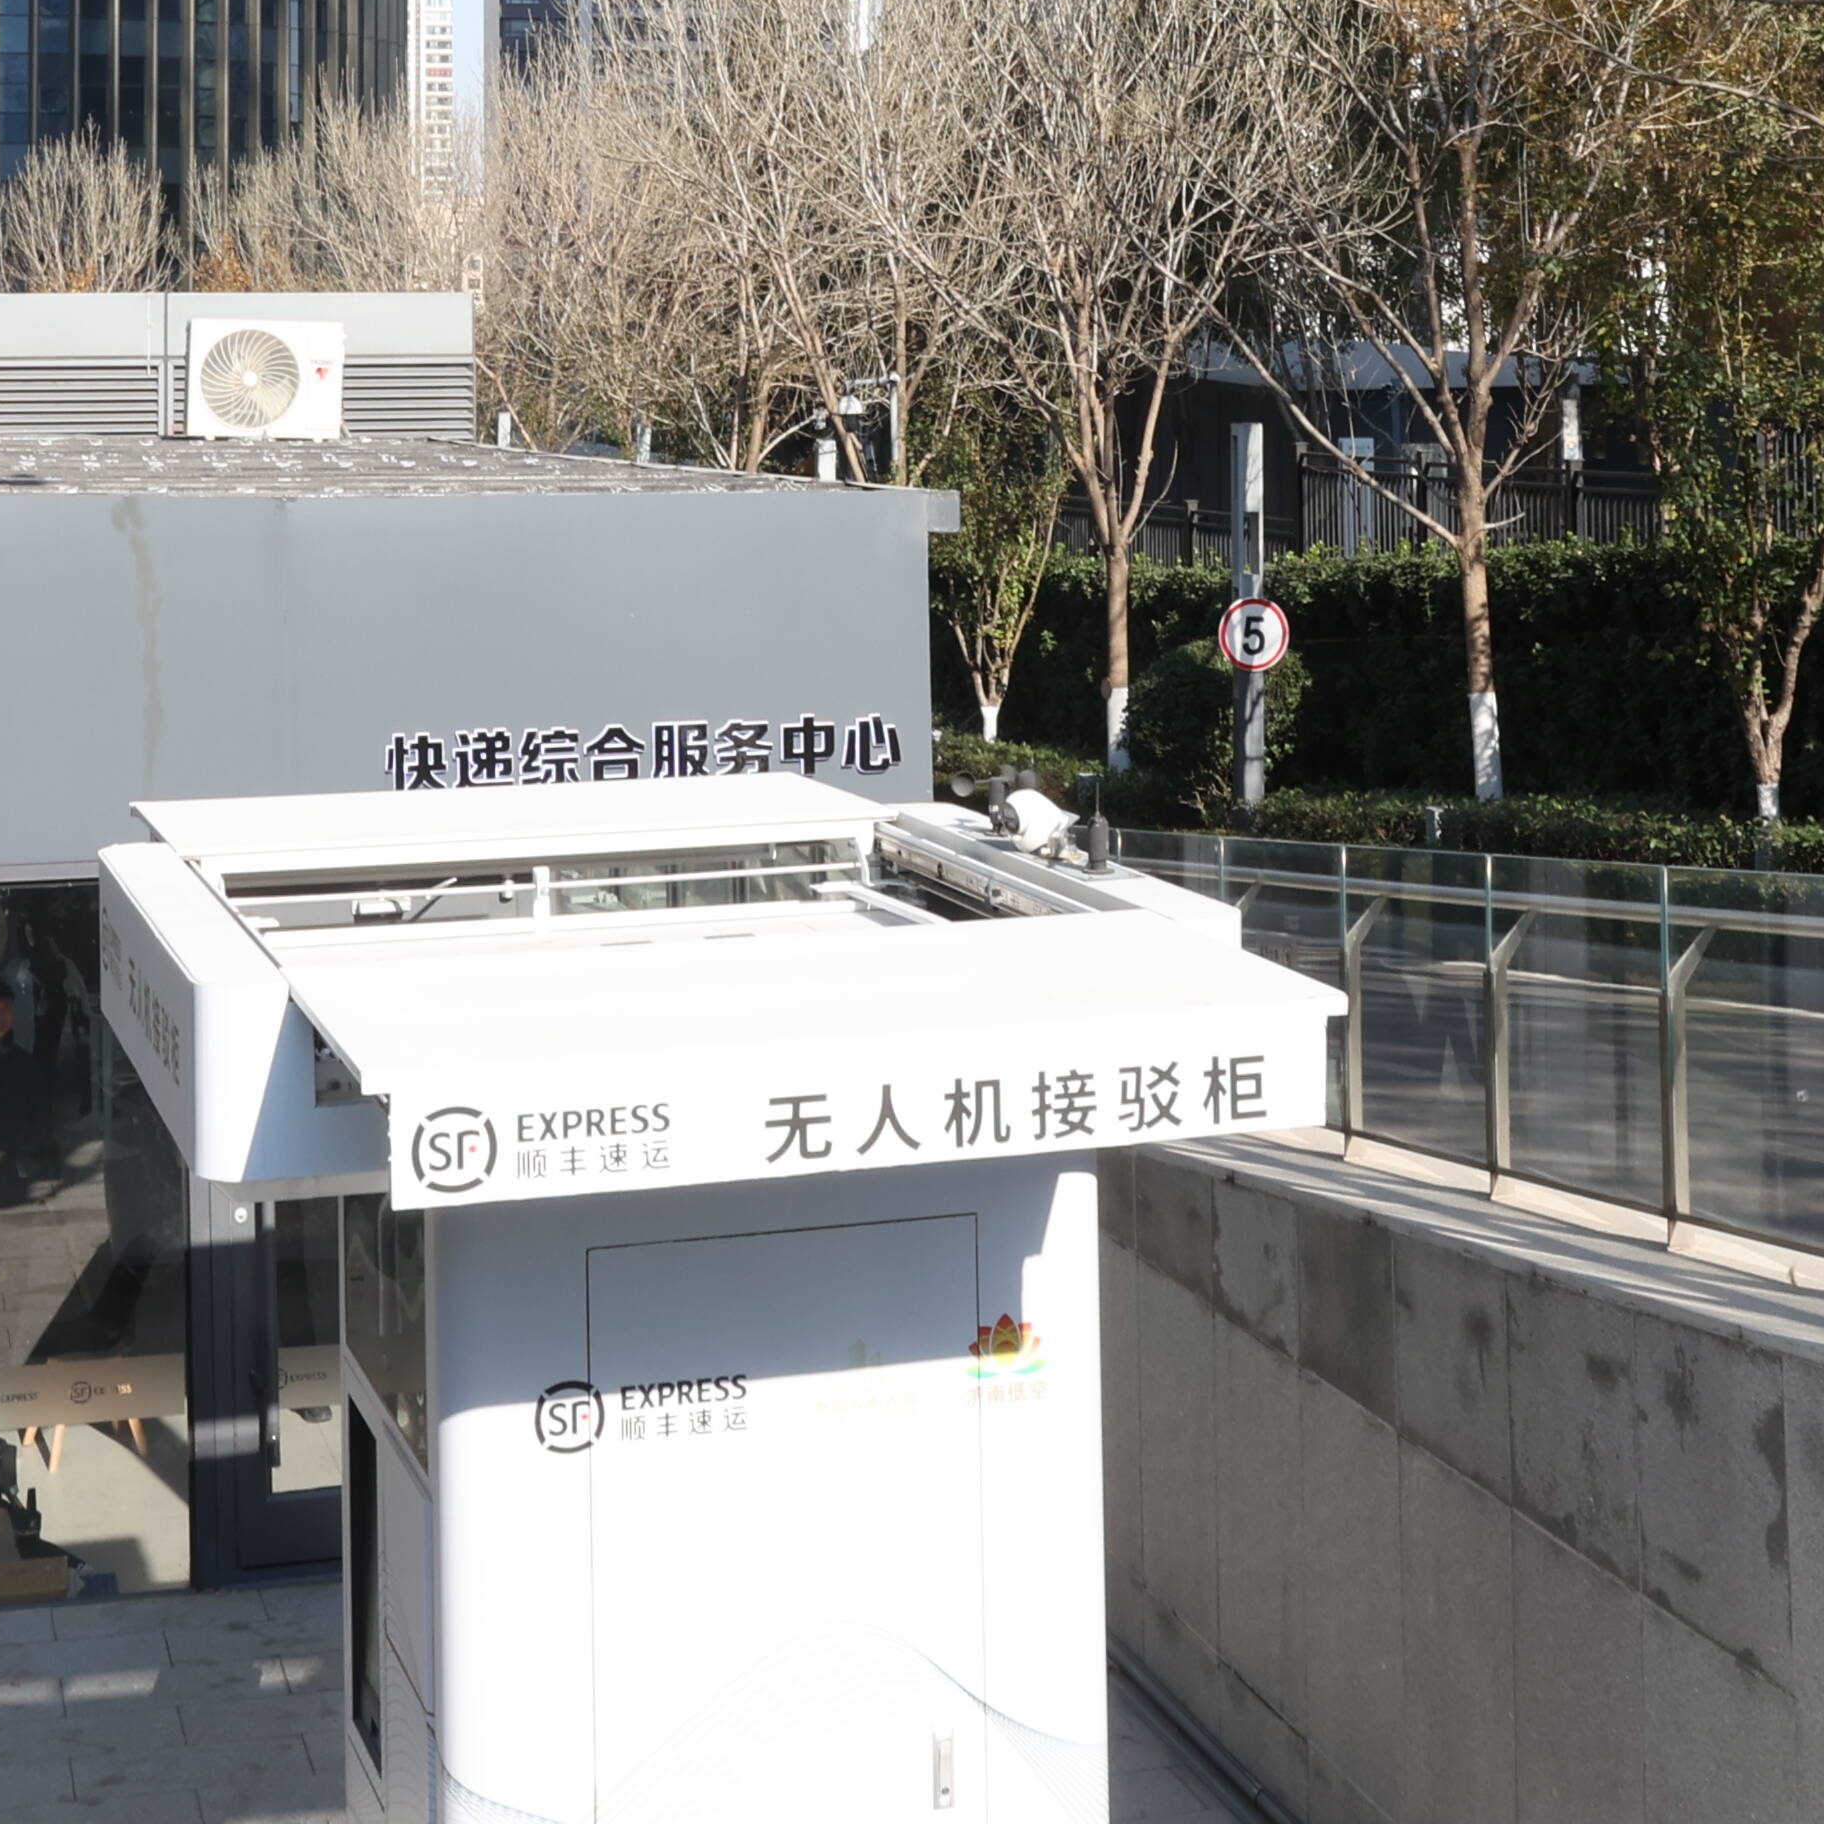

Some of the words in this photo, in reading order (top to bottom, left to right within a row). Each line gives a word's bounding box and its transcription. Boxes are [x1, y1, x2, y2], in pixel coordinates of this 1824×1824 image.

[1242, 616, 1265, 655] 5
[384, 713, 902, 791] 快递综合服务中心
[516, 1102, 671, 1143] EXPRESS
[764, 1054, 1268, 1165] 无人机接驳柜
[515, 1139, 671, 1179] 顺丰速运
[620, 1374, 747, 1411] EXPRESS
[966, 1379, 1048, 1407] 济南低空
[620, 1405, 748, 1441] 顺丰速运
